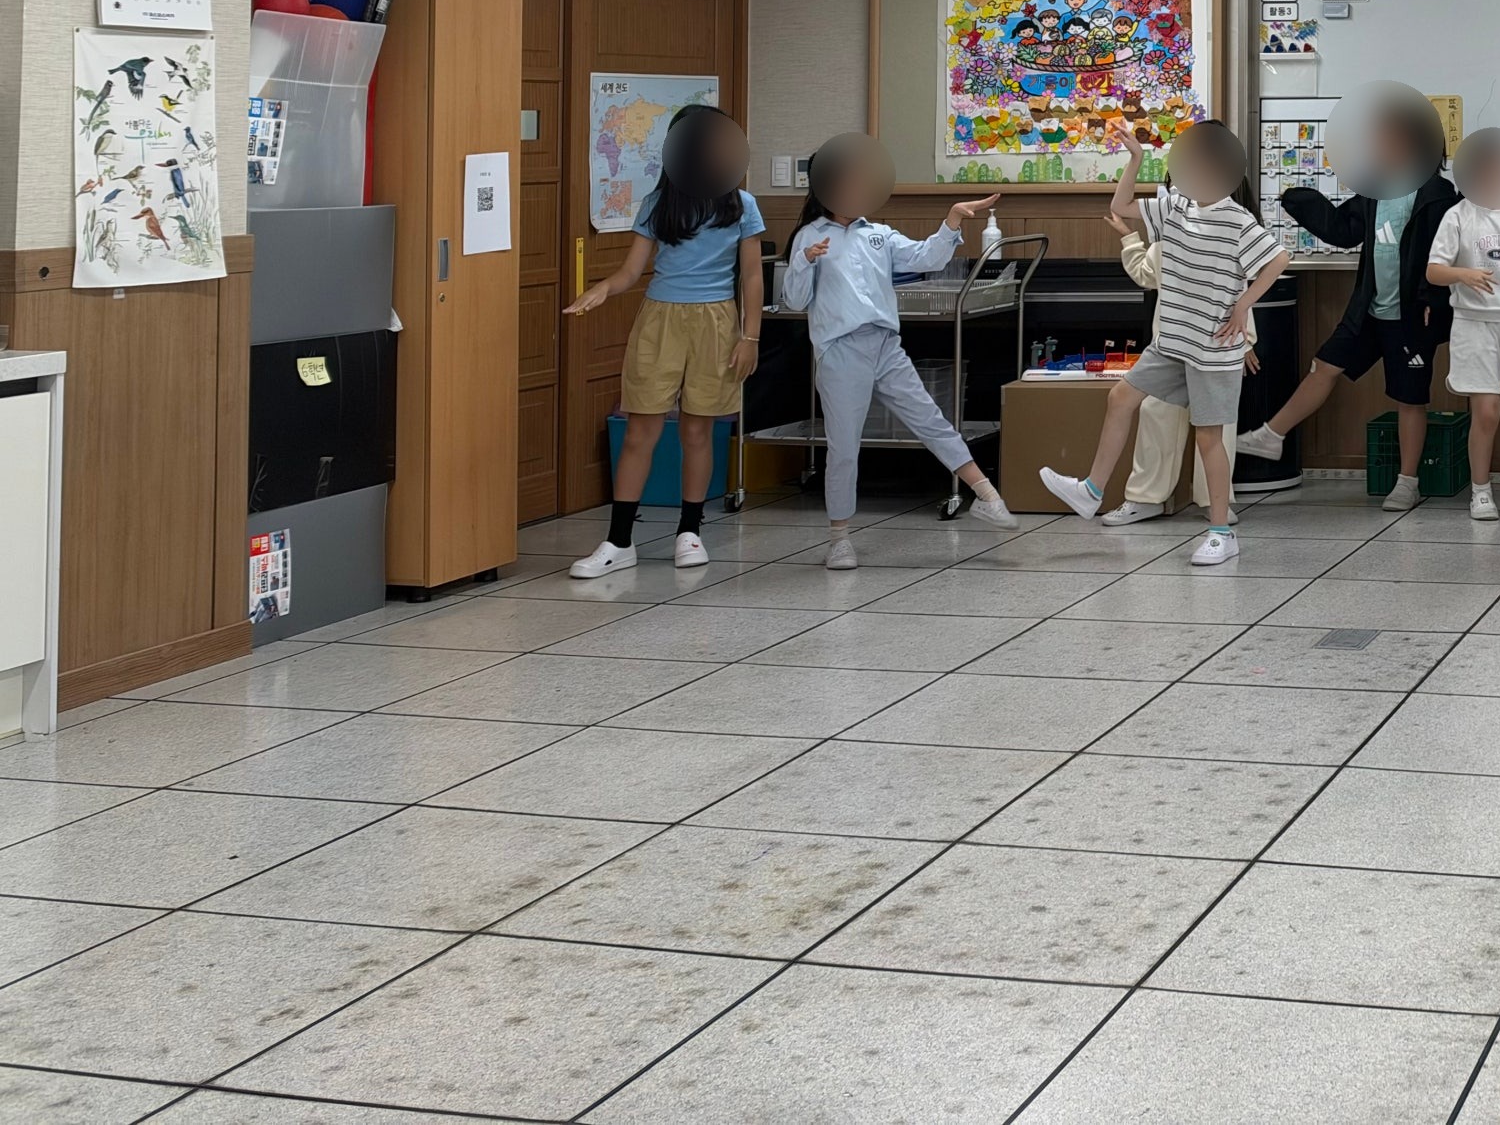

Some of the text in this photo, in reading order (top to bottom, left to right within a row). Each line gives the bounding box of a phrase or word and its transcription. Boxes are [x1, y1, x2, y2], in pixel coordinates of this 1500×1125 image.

[1269, 6, 1292, 16] 활동3
[600, 83, 628, 93] 세계 전도
[1028, 75, 1073, 90] 가을아
[302, 362, 326, 381] 6학년
